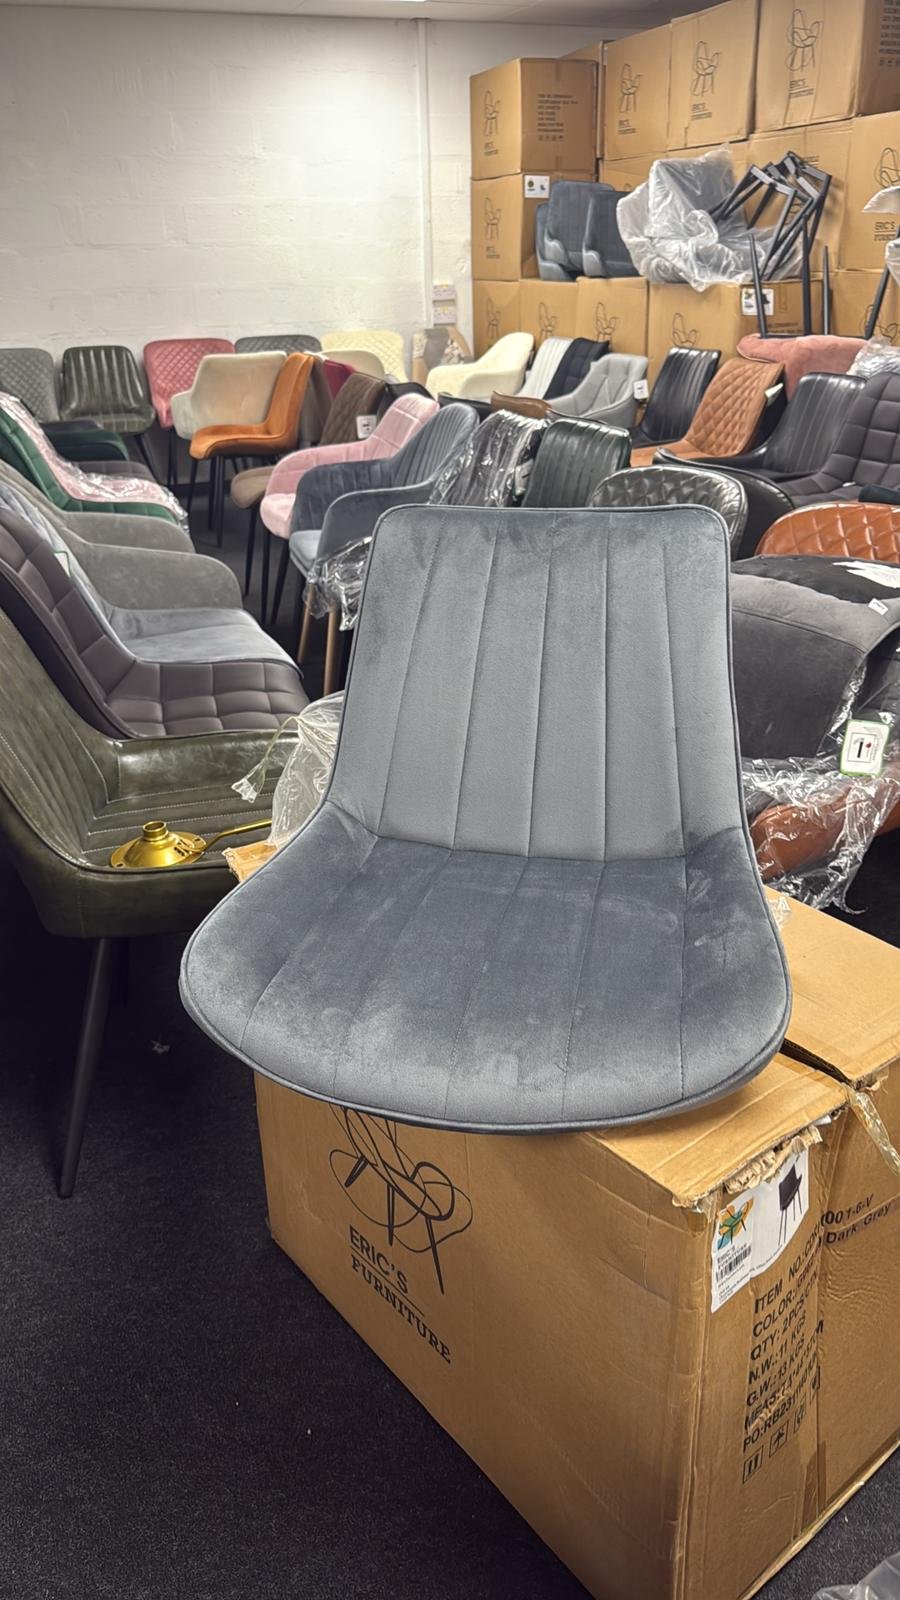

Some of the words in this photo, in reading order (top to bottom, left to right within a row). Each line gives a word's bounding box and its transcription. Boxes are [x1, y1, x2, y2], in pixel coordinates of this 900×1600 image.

[349, 1224, 408, 1294] ERIC'S
[753, 1289, 795, 1338] COLOR:
[826, 1223, 857, 1244] Dark
[351, 1254, 450, 1364] FURNITURE
[754, 1279, 783, 1314] ITEM
[750, 1329, 780, 1361] QTY:
